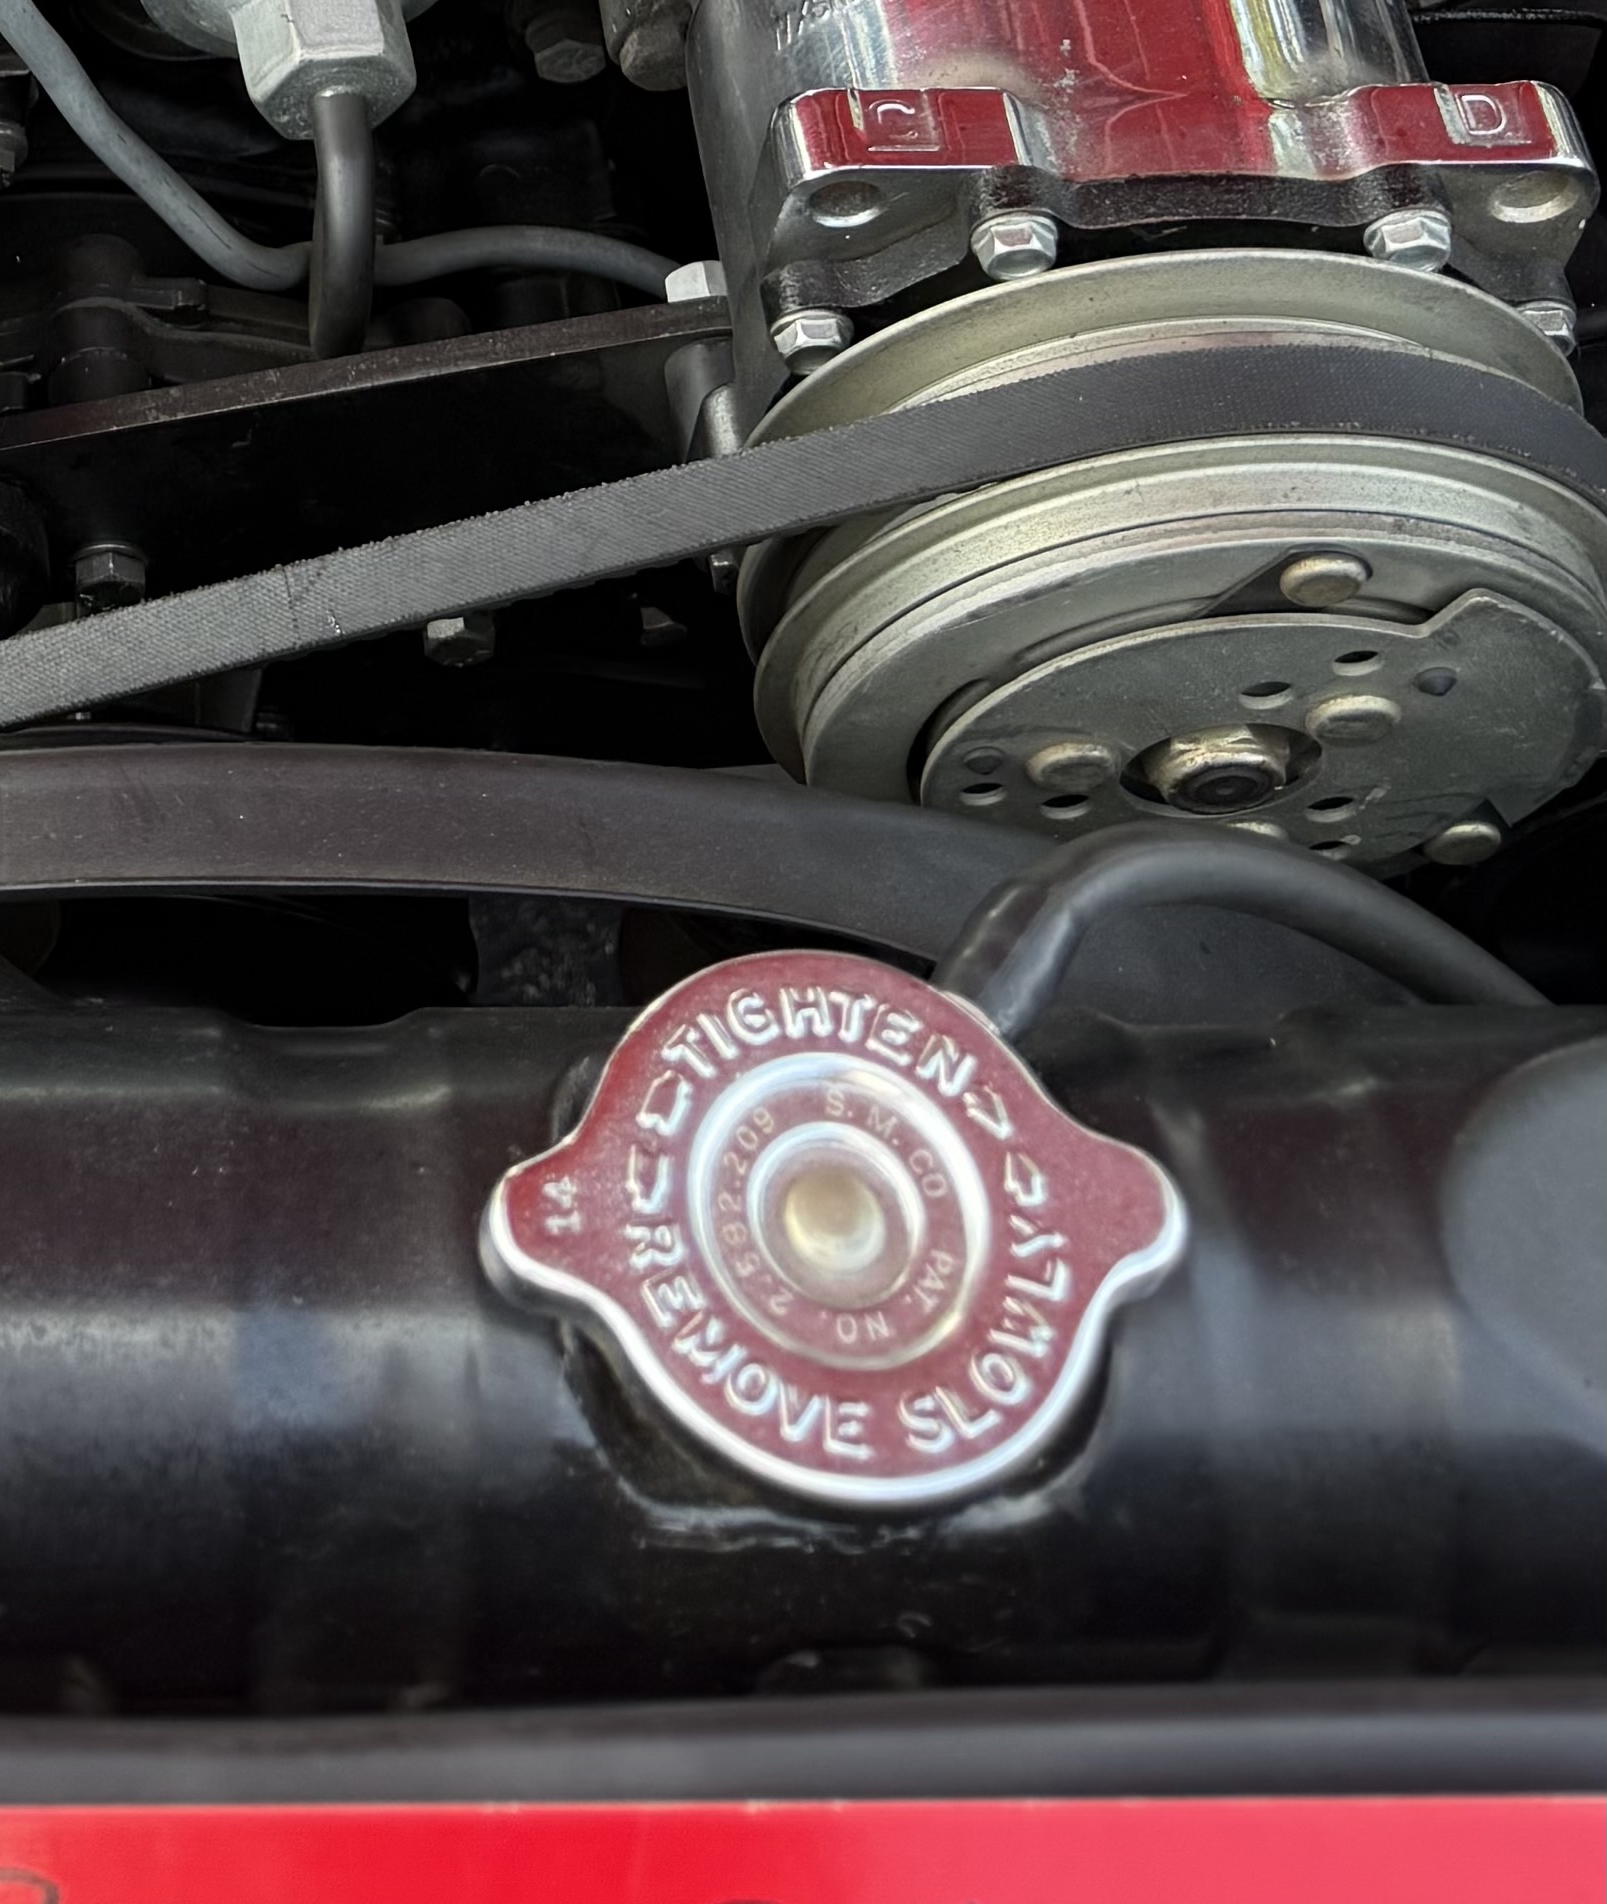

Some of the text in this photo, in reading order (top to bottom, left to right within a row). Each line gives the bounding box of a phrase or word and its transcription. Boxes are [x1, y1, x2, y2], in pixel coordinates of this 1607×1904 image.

[662, 986, 977, 1099] TIGHTEN
[543, 1175, 582, 1238] 14
[623, 1214, 1070, 1460] REMOVE SLOWLY
